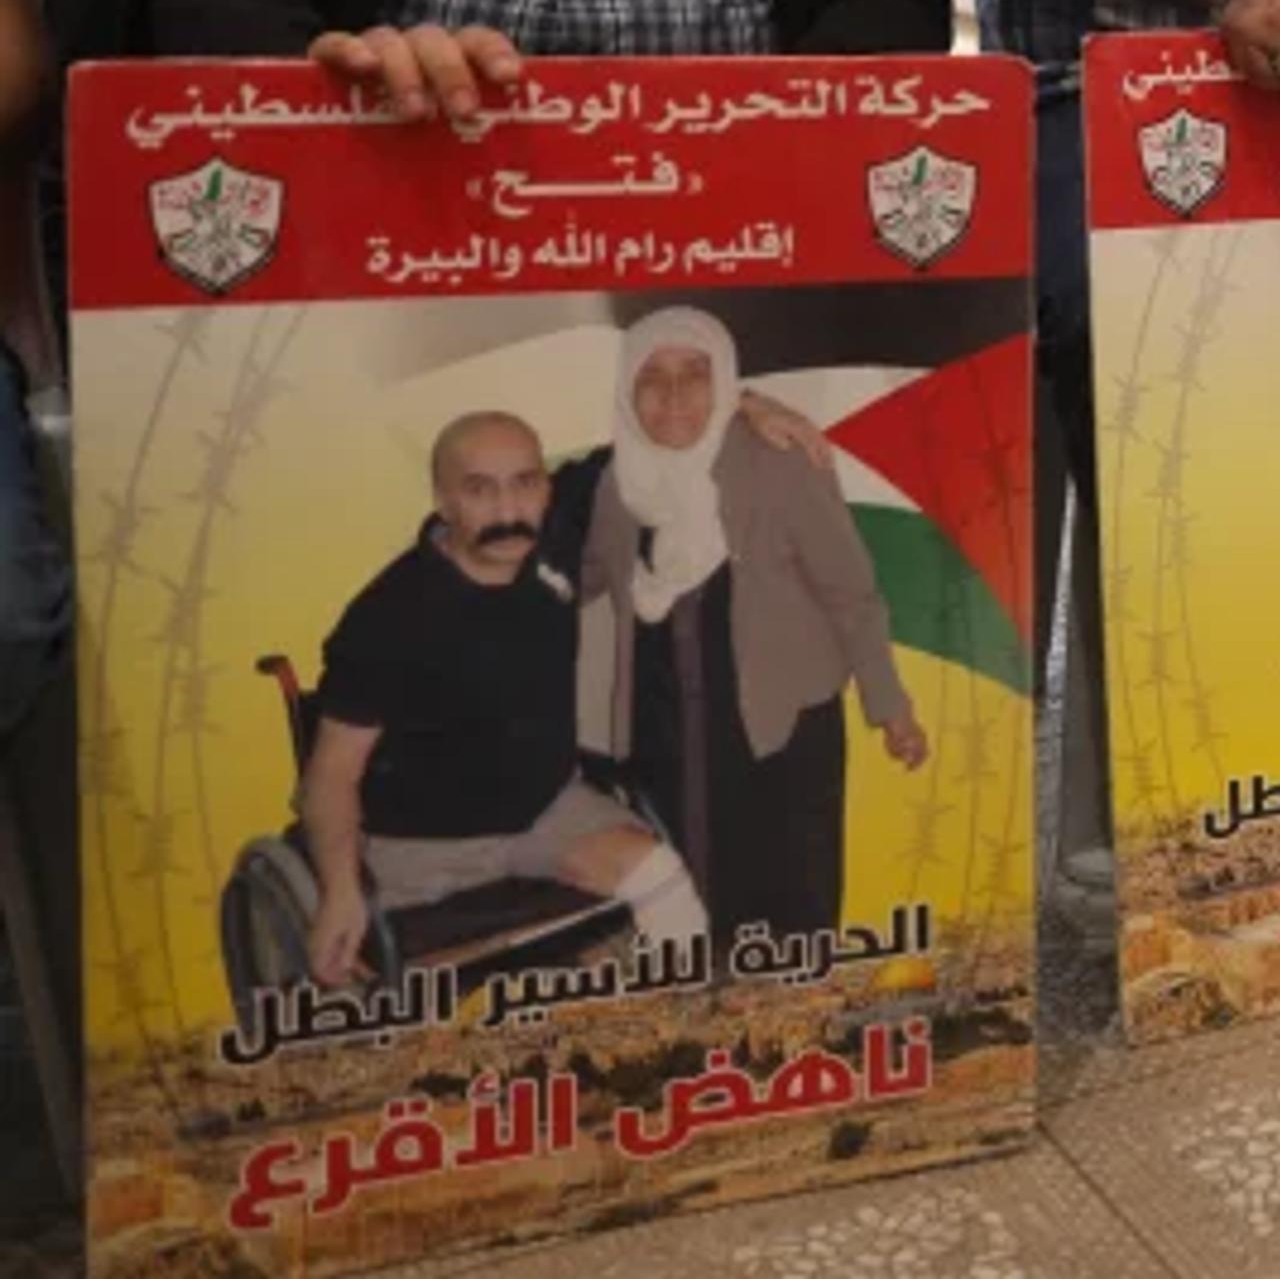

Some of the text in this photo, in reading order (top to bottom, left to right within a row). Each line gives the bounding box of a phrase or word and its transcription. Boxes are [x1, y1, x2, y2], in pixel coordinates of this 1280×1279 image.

[655, 81, 849, 134] التحرير
[860, 75, 991, 120] حركة
[365, 214, 795, 278] إقليم رام الله والبيرة
[219, 905, 930, 1066] الحرية للأسير البطل
[229, 1018, 934, 1230] ناهض الأقرع
